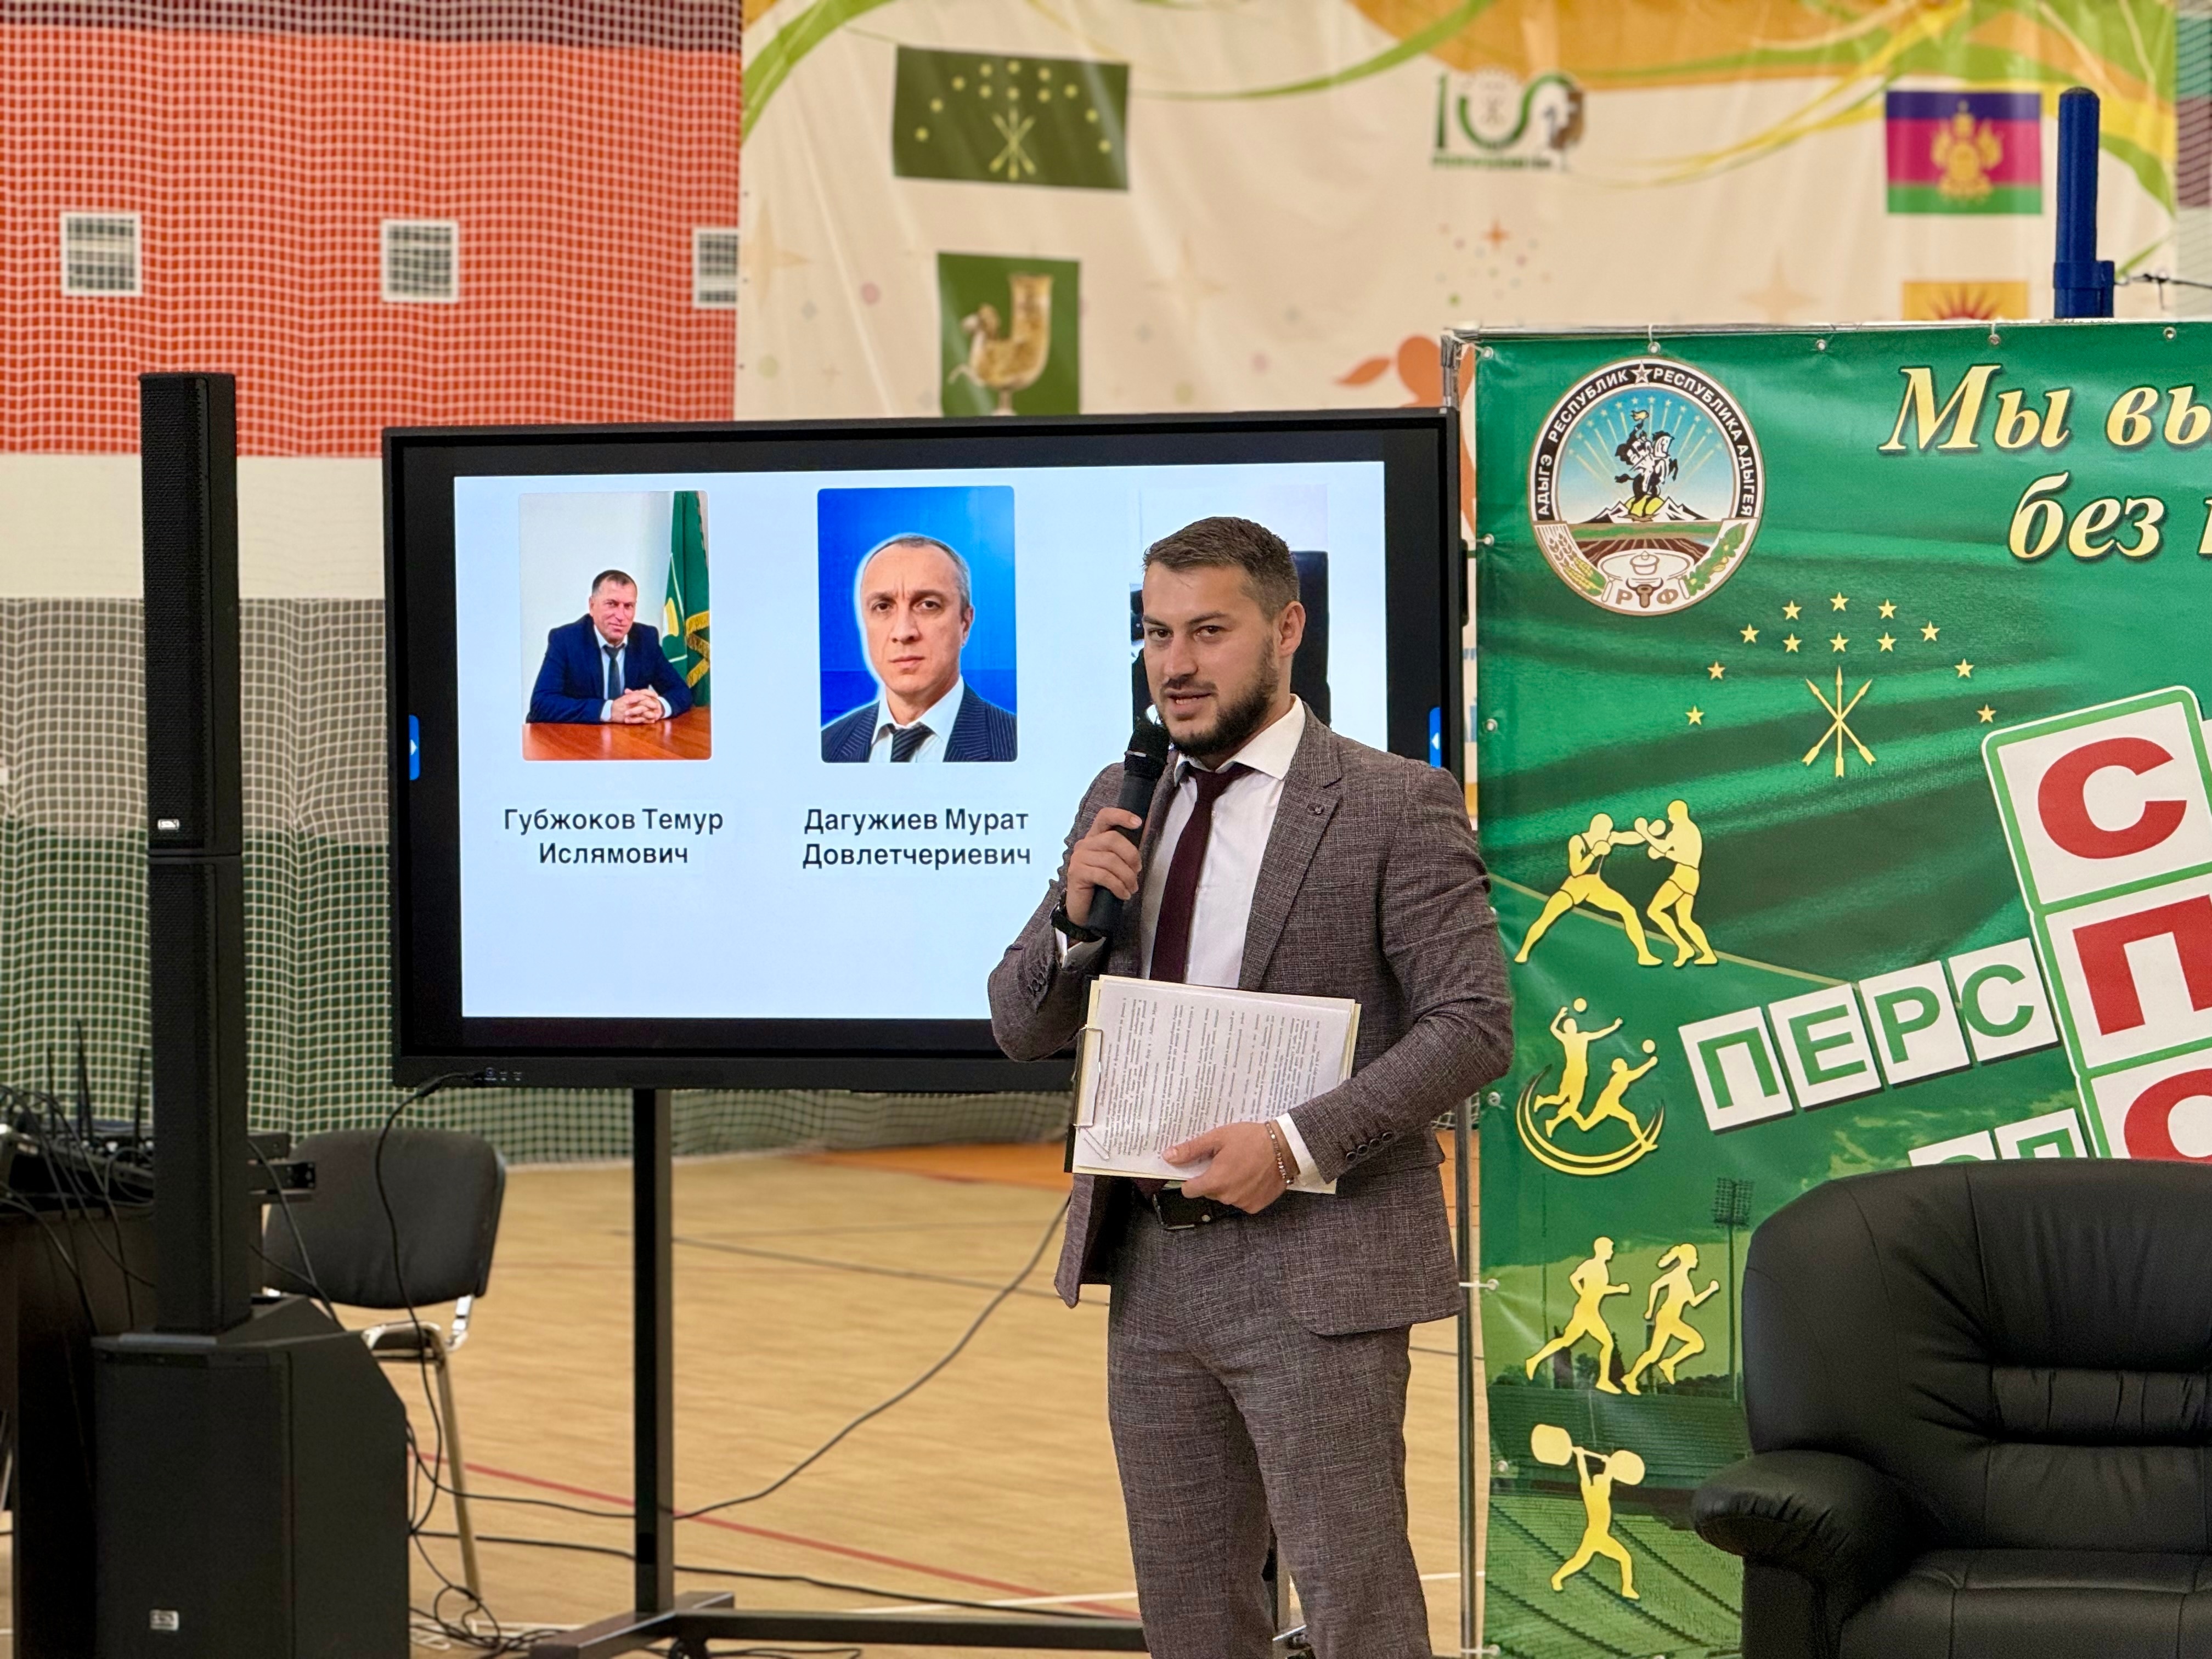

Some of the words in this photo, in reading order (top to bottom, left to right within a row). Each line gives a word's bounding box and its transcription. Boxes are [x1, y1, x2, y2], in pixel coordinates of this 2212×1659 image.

[1878, 364, 2072, 450] Мы
[1537, 454, 1553, 516] АДЫГЭ
[1549, 369, 1629, 444] РЕСПУБЛИК
[1652, 368, 1743, 443] РЕСПУБЛИКА
[1736, 444, 1756, 517] АДЫГЕЯ
[2008, 471, 2165, 558] без
[504, 807, 635, 836] Губжоков
[642, 808, 724, 836] Темур
[804, 807, 938, 836] Дагужиев
[945, 808, 1029, 836] Мурат
[539, 842, 689, 865] Ислямович
[802, 843, 1031, 871] Довлетчериевич
